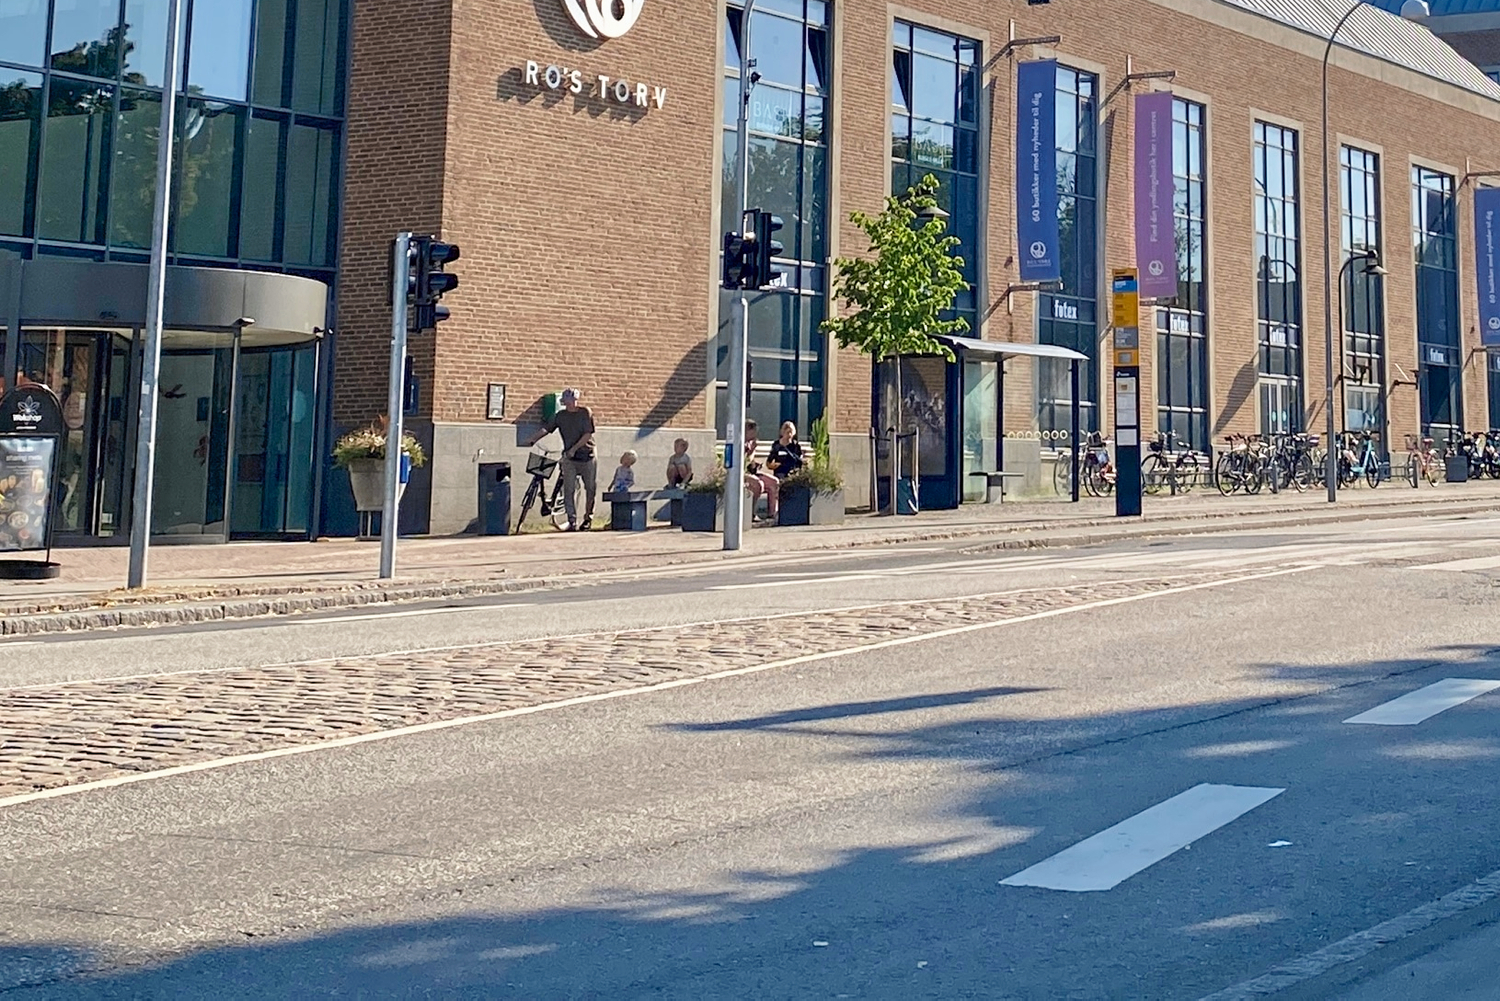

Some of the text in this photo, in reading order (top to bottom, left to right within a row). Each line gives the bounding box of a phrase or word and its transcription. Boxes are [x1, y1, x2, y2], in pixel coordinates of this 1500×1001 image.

[526, 60, 667, 109] RO'S TORV
[1032, 92, 1042, 222] 60 butikker med nyheder til dig
